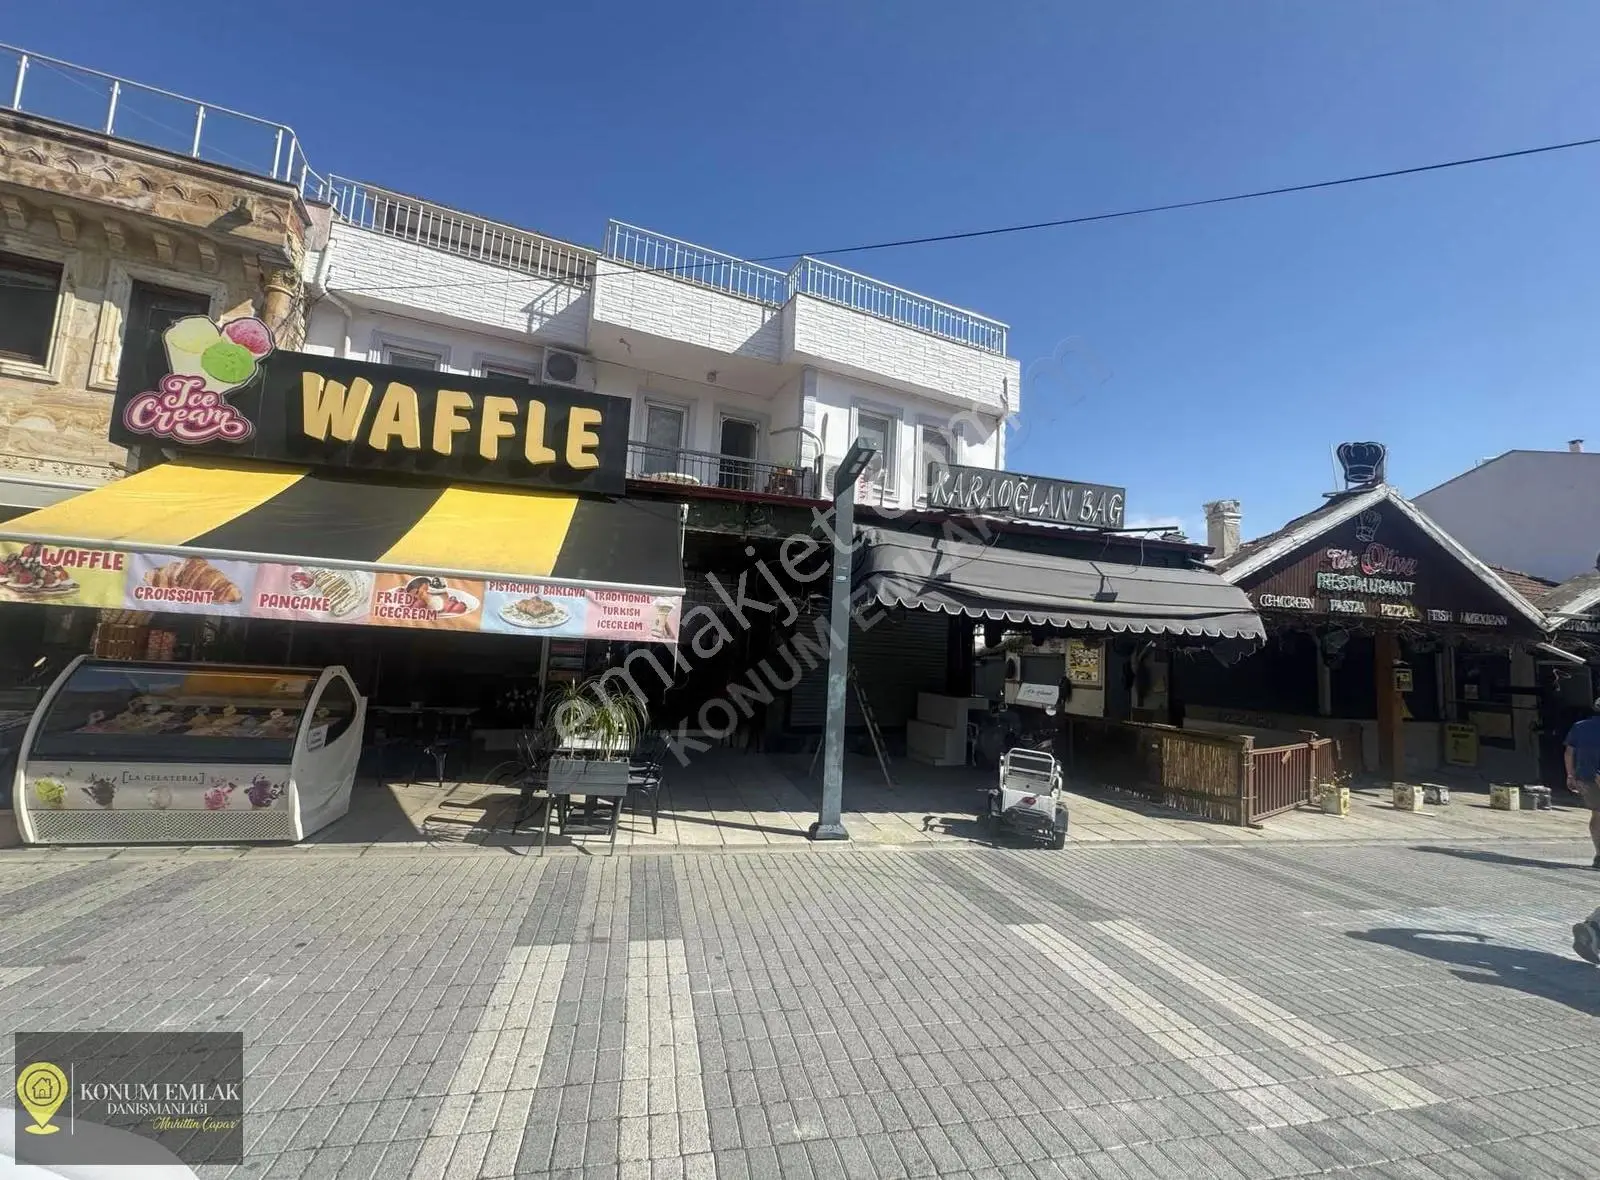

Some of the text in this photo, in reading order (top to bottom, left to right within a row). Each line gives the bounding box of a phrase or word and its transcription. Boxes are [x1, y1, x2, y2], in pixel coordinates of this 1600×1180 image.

[164, 378, 216, 408] Ice
[132, 398, 244, 437] Cream
[302, 371, 604, 470] WAFFLE
[932, 470, 1074, 521] KARAOĞLAN
[41, 547, 124, 571] WAFFLE
[134, 587, 214, 604] CROISSANT
[488, 581, 585, 598] PISTACHIO BAKLAVA
[594, 591, 652, 604] TRADITIONAL
[259, 594, 331, 612] PANCAKE
[376, 591, 413, 606] FRIED
[374, 606, 437, 621] ICECREAM
[603, 606, 641, 617] TURKISH
[597, 619, 643, 631] ICECREAM
